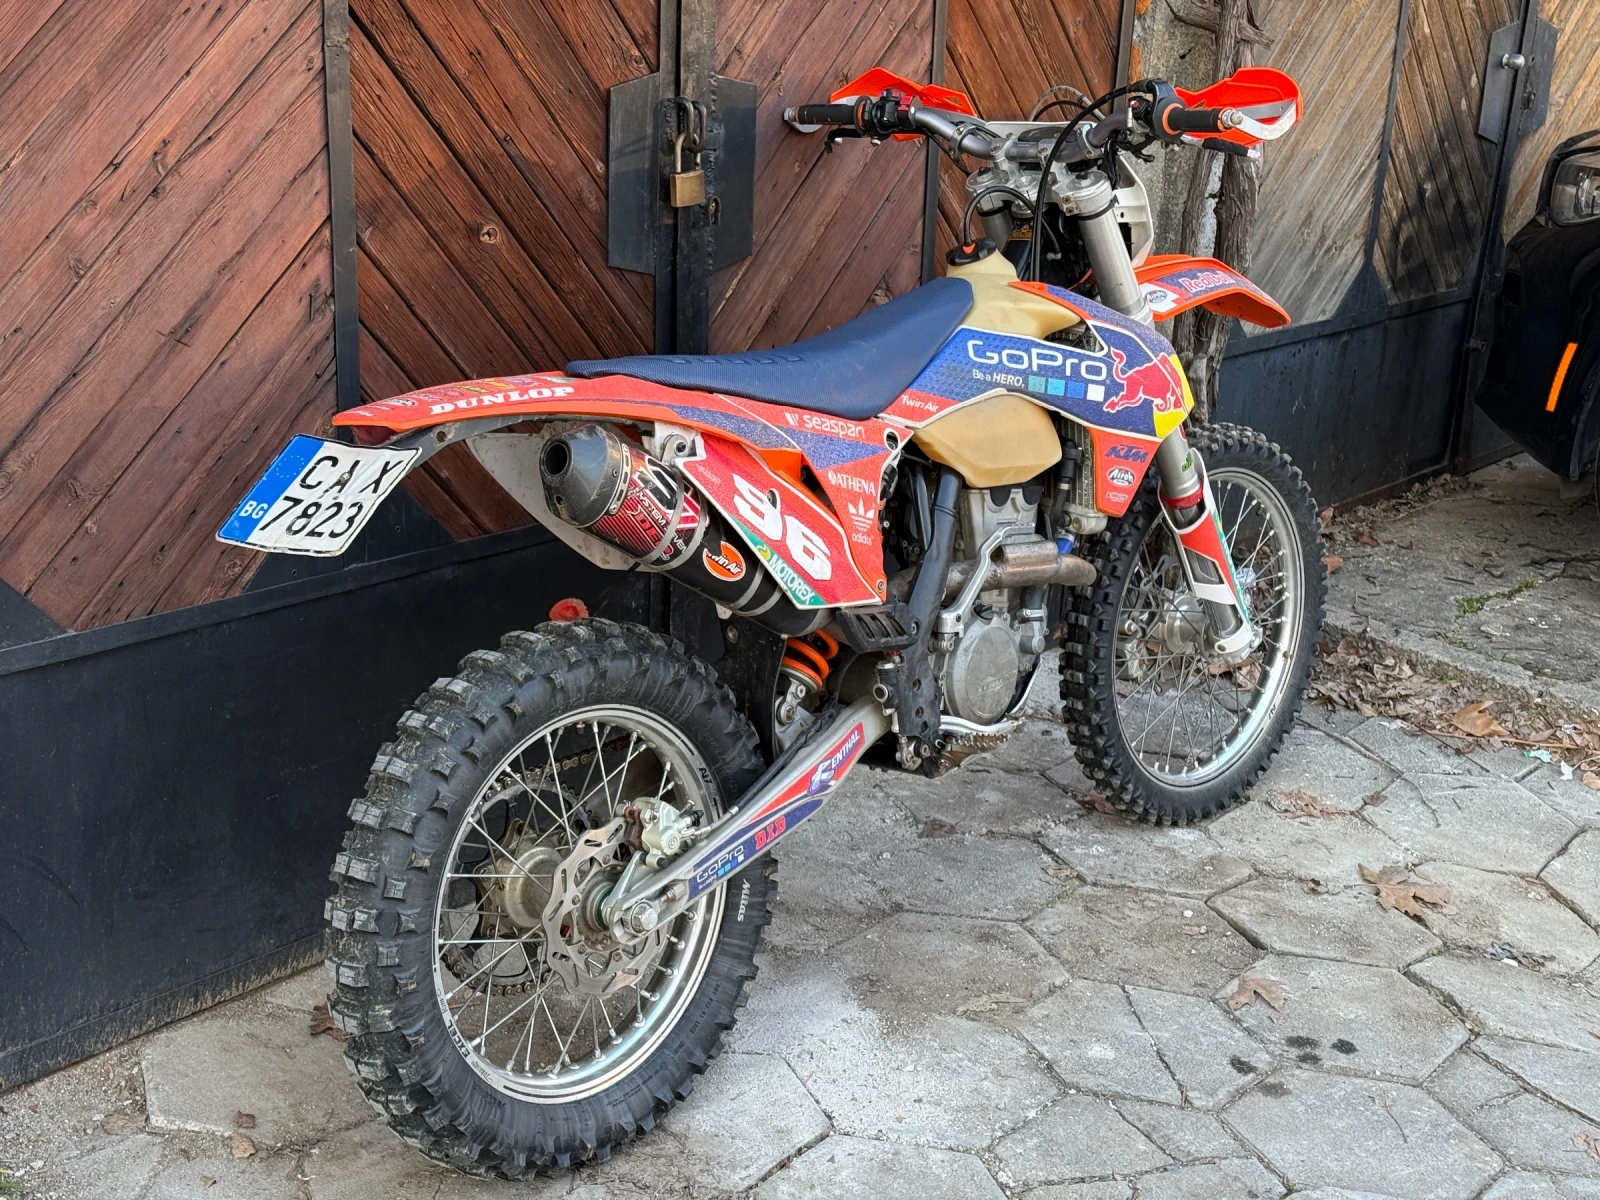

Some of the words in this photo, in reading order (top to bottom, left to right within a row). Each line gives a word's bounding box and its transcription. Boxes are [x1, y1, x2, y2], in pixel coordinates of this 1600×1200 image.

[967, 340, 1107, 381] GoPro
[973, 369, 984, 380] Be
[429, 386, 575, 415] DUNLOP
[901, 395, 924, 408] Twin
[924, 401, 939, 413] Air
[803, 414, 865, 439] seaspan
[1105, 444, 1149, 463] KTM
[836, 473, 876, 497] ATHENA
[1109, 467, 1134, 484] Airoh
[239, 500, 269, 519] BG
[259, 496, 364, 539] 7823
[852, 532, 873, 546] adidas
[769, 553, 816, 605] MOTOREX
[696, 845, 744, 883] GoPro
[447, 1018, 471, 1059] EXCEL
